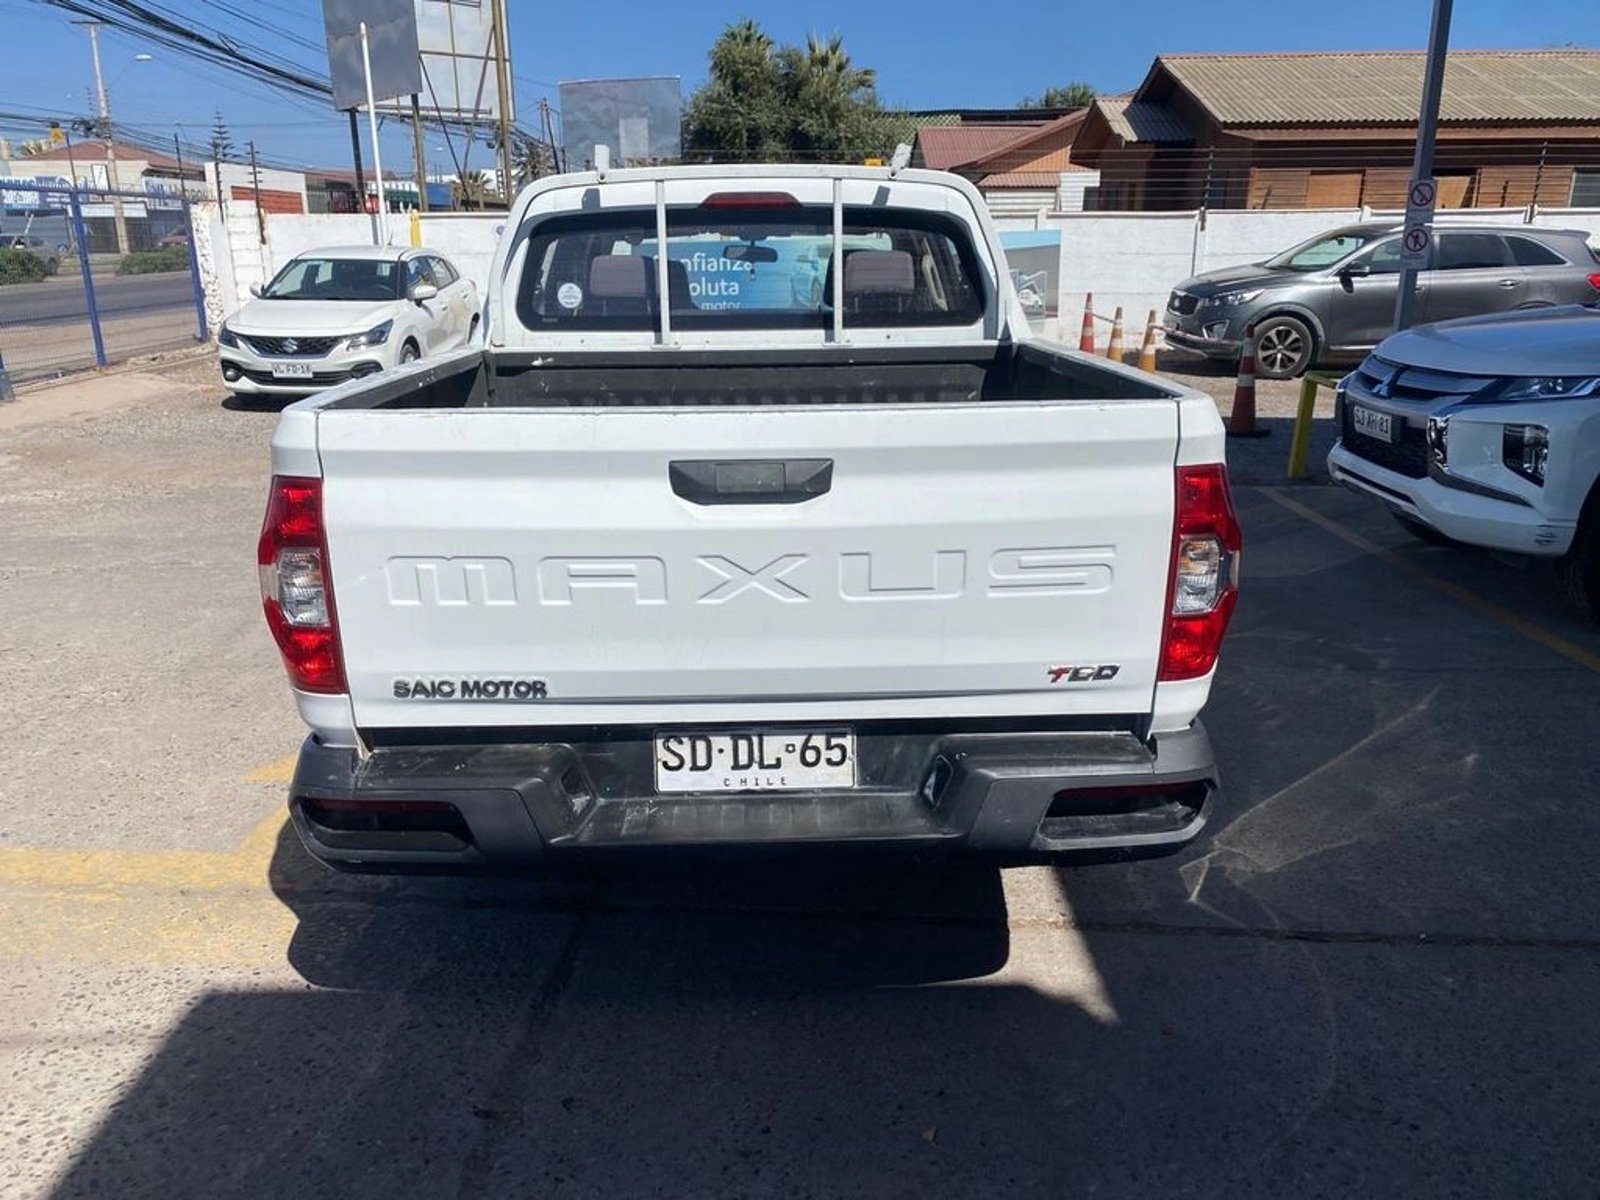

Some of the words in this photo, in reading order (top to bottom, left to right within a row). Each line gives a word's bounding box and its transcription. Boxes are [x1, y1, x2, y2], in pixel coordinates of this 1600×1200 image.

[680, 252, 753, 272] nfianza
[688, 277, 740, 296] oluta
[385, 544, 1116, 606] MAXUS
[392, 680, 456, 699] SAIC
[460, 679, 548, 699] MOTOR
[723, 776, 788, 787] CHILE
